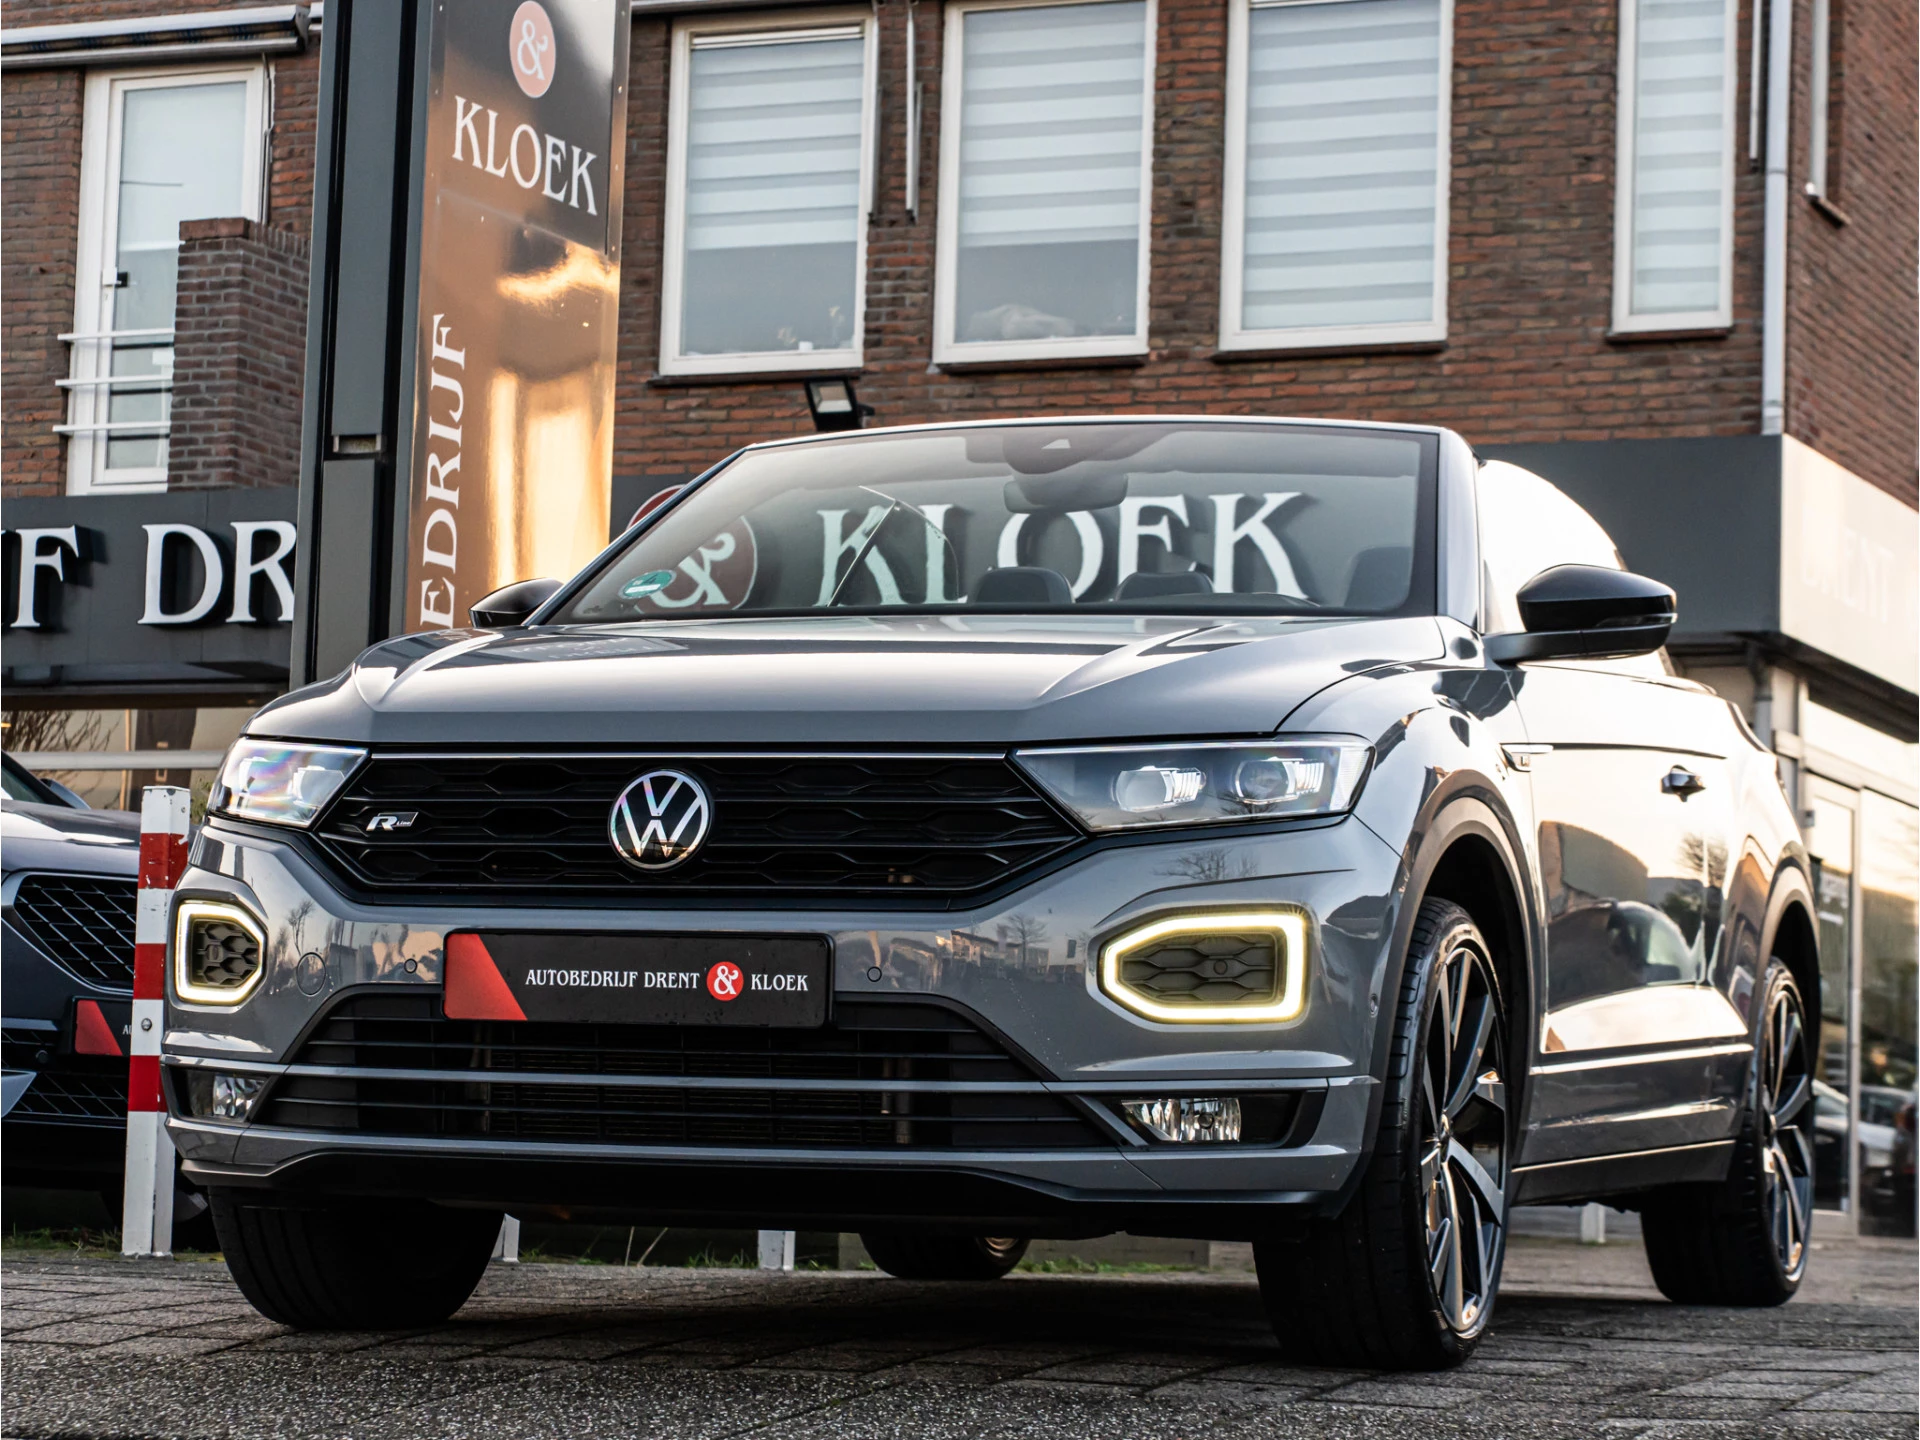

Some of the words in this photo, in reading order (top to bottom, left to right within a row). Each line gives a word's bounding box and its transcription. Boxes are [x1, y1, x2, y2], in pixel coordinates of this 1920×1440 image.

[516, 19, 549, 81] &
[452, 95, 598, 216] KLOEK
[420, 313, 466, 629] EDRIJF
[1, 524, 79, 627] F
[137, 520, 297, 625] DR
[525, 968, 639, 989] AUTOBEDRIJF
[643, 971, 700, 989] DRENT
[713, 965, 739, 995] &
[750, 974, 809, 992] KLOEK
